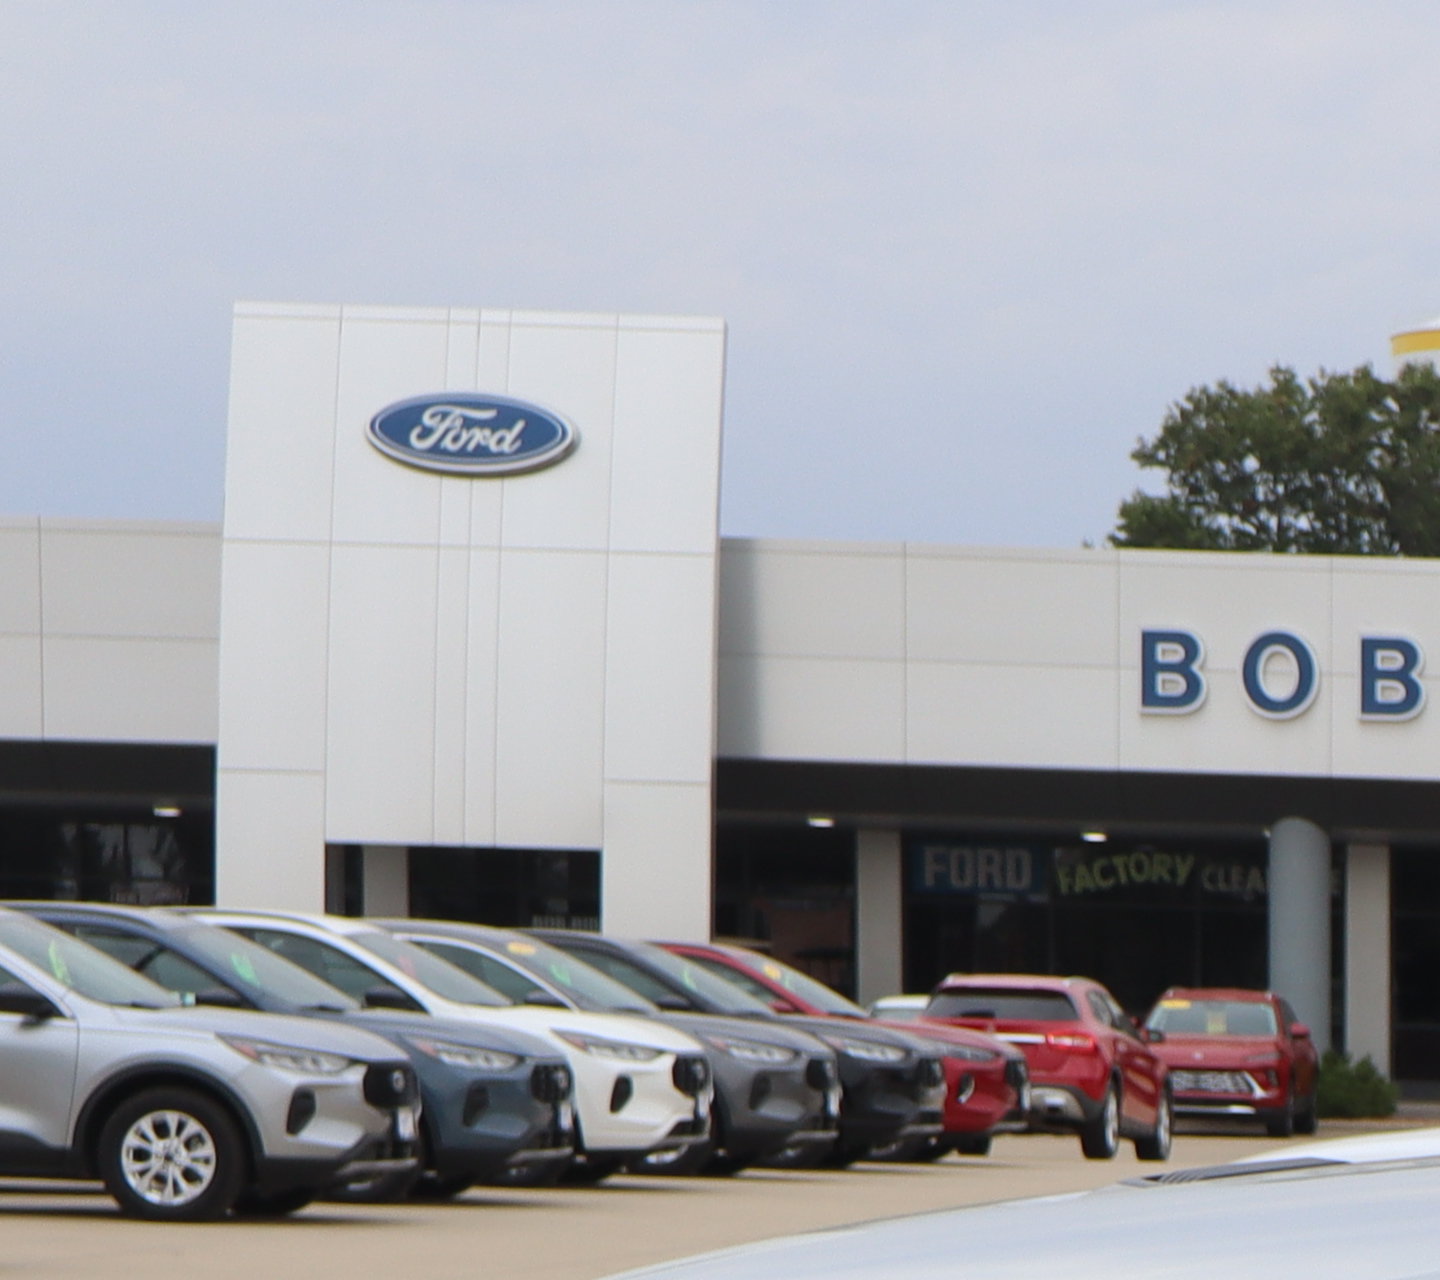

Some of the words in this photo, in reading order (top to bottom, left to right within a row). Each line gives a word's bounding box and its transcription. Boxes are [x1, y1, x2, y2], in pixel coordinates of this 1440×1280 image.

[408, 404, 527, 454] Ford
[1140, 629, 1427, 721] BOB
[922, 845, 1034, 889] FORD
[1054, 850, 1196, 896] FACTORY
